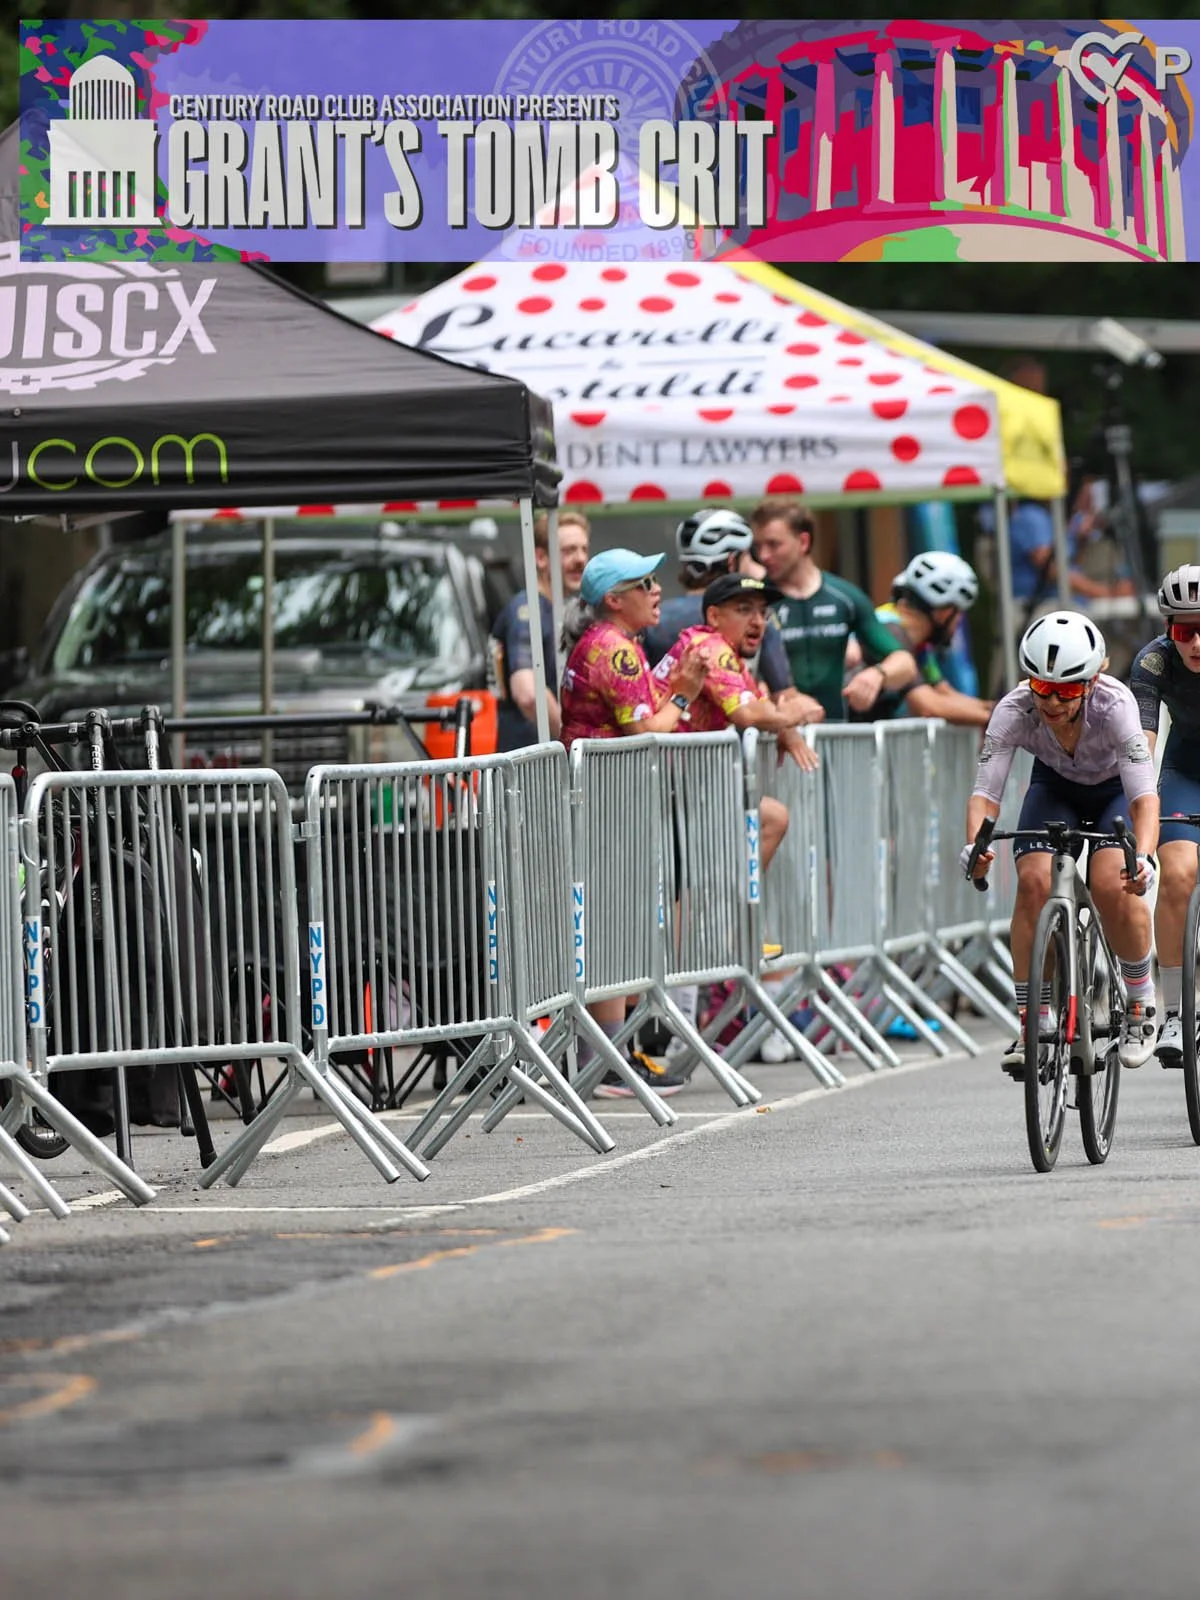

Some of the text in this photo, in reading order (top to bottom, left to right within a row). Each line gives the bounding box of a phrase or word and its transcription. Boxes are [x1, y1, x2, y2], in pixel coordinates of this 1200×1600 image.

[415, 302, 785, 352] Lucarelli
[547, 368, 766, 400] staldi
[679, 434, 839, 465] LAWYERS
[745, 814, 759, 899] NYPD
[25, 919, 41, 1024] NYPD
[573, 886, 584, 978] NYPD
[308, 925, 325, 1026] NYPD
